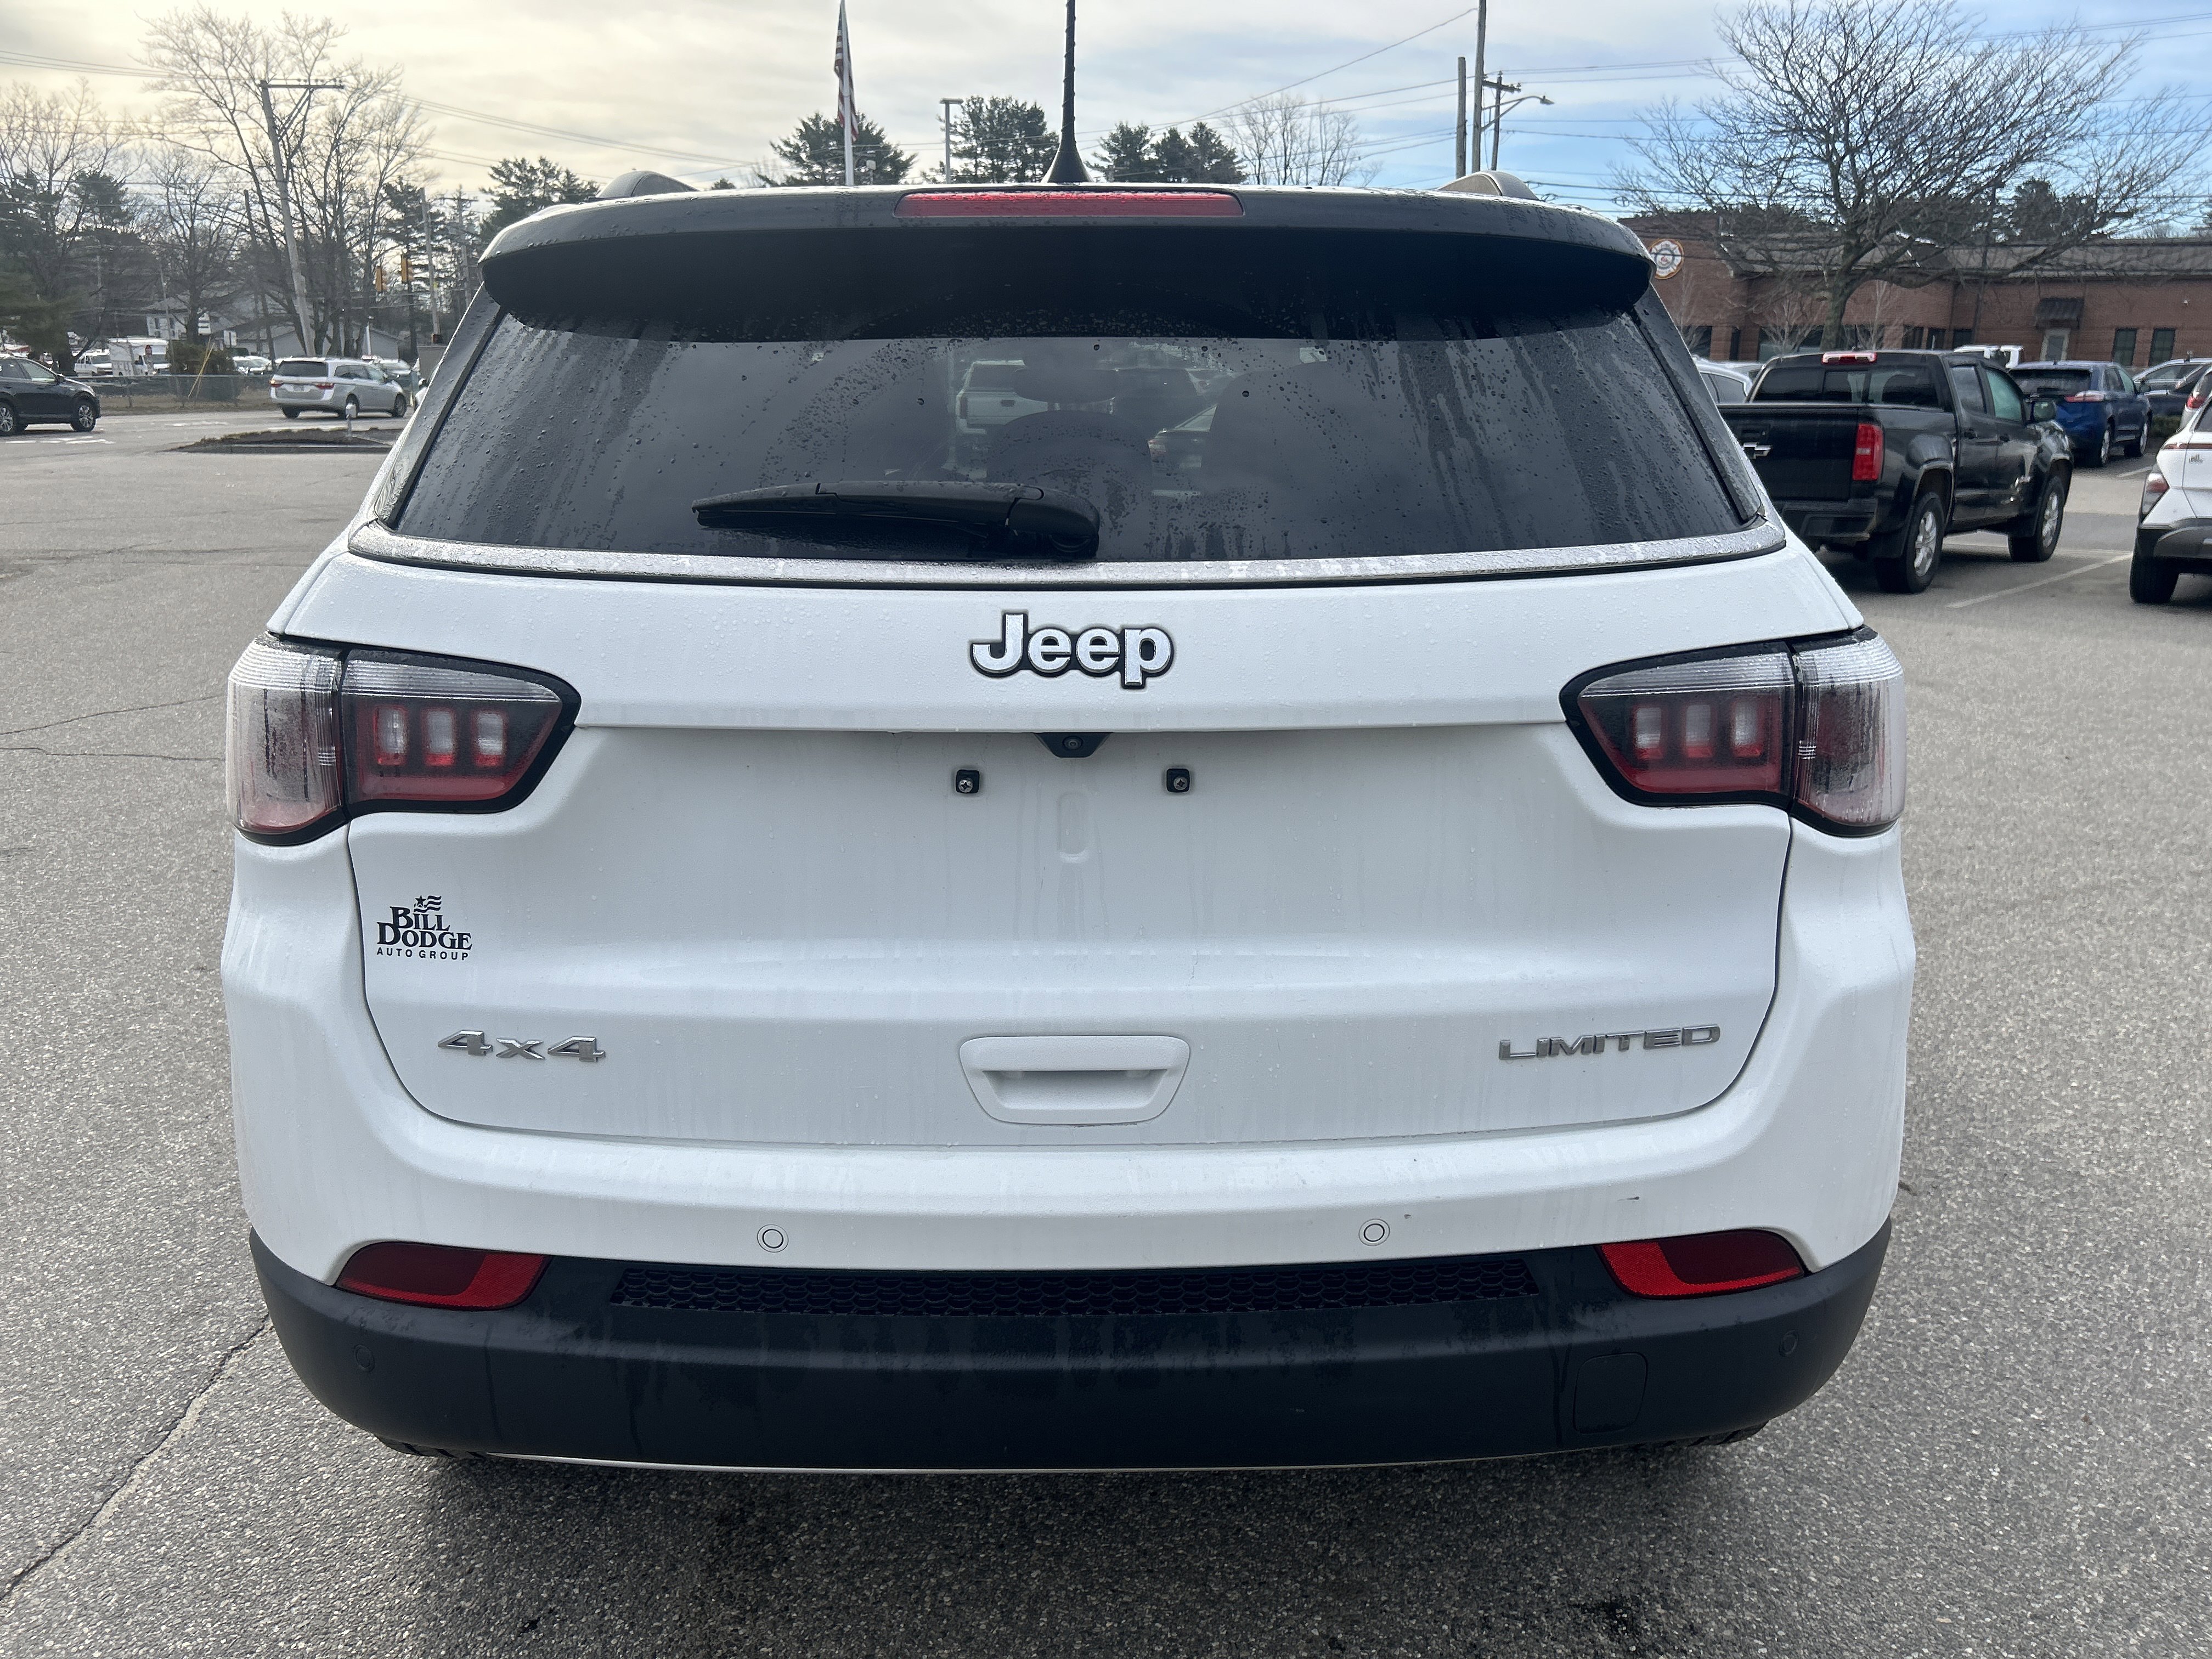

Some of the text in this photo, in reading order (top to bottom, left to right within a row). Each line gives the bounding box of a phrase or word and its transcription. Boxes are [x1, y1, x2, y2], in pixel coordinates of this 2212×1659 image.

[970, 611, 1173, 689] Jeep
[390, 906, 450, 931] BILL
[376, 922, 472, 950] DODGE
[376, 947, 469, 960] AUTO GROUP
[1498, 1024, 1720, 1060] LIMITED
